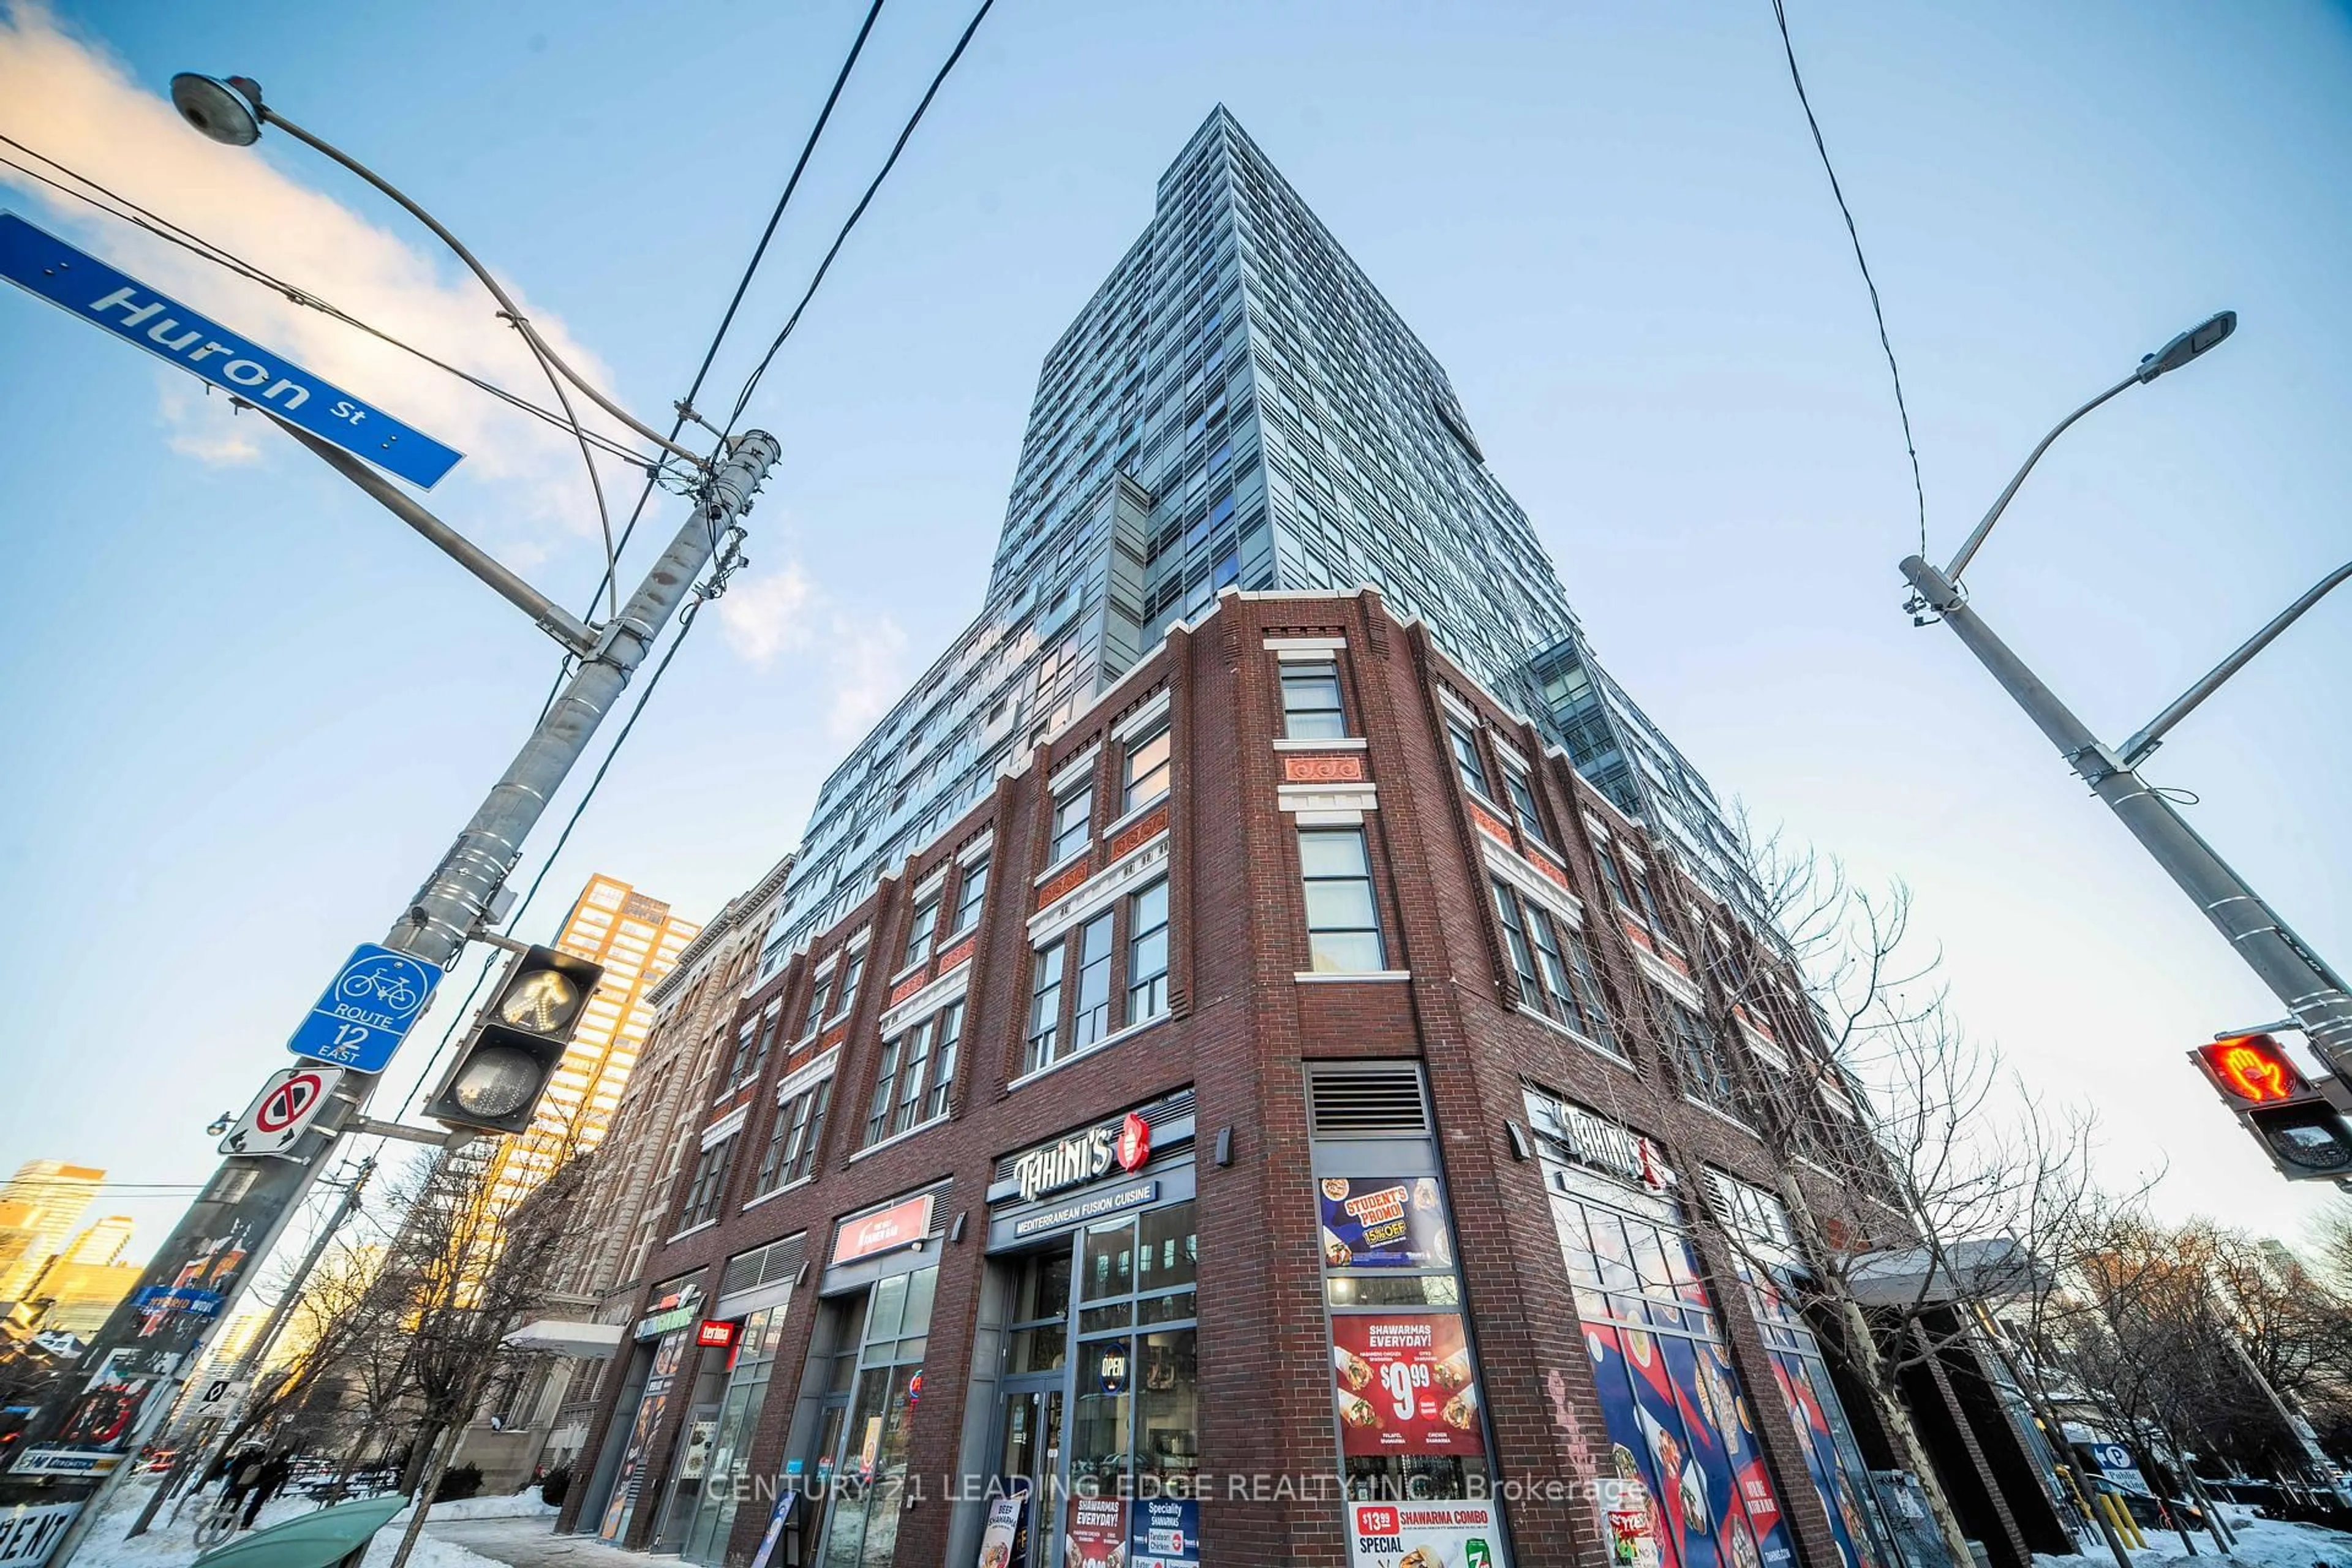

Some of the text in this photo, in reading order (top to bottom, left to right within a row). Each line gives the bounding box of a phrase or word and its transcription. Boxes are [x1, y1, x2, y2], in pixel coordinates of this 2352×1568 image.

[89, 286, 367, 426] Huron St
[334, 1003, 394, 1030] ROUTE
[333, 1023, 370, 1050] 12
[317, 1046, 360, 1064] EAST
[1346, 1188, 1407, 1214] STUDENT'S
[1017, 1186, 1150, 1234] MEDITERRANEAN FUSION CUISINE
[1370, 1325, 1431, 1335] SHAWARMAS
[1370, 1335, 1431, 1347] EVERYDAY!
[1102, 1356, 1125, 1377] OPEN
[2108, 1471, 2138, 1480] Public
[1078, 1499, 1120, 1512] SHAWARMAS
[1148, 1501, 1182, 1518] Speciality
[1077, 1512, 1119, 1528] EVERYDAY!
[1400, 1510, 1488, 1525] SHAWARMA COMBO
[1360, 1537, 1404, 1553] SPECIAL
